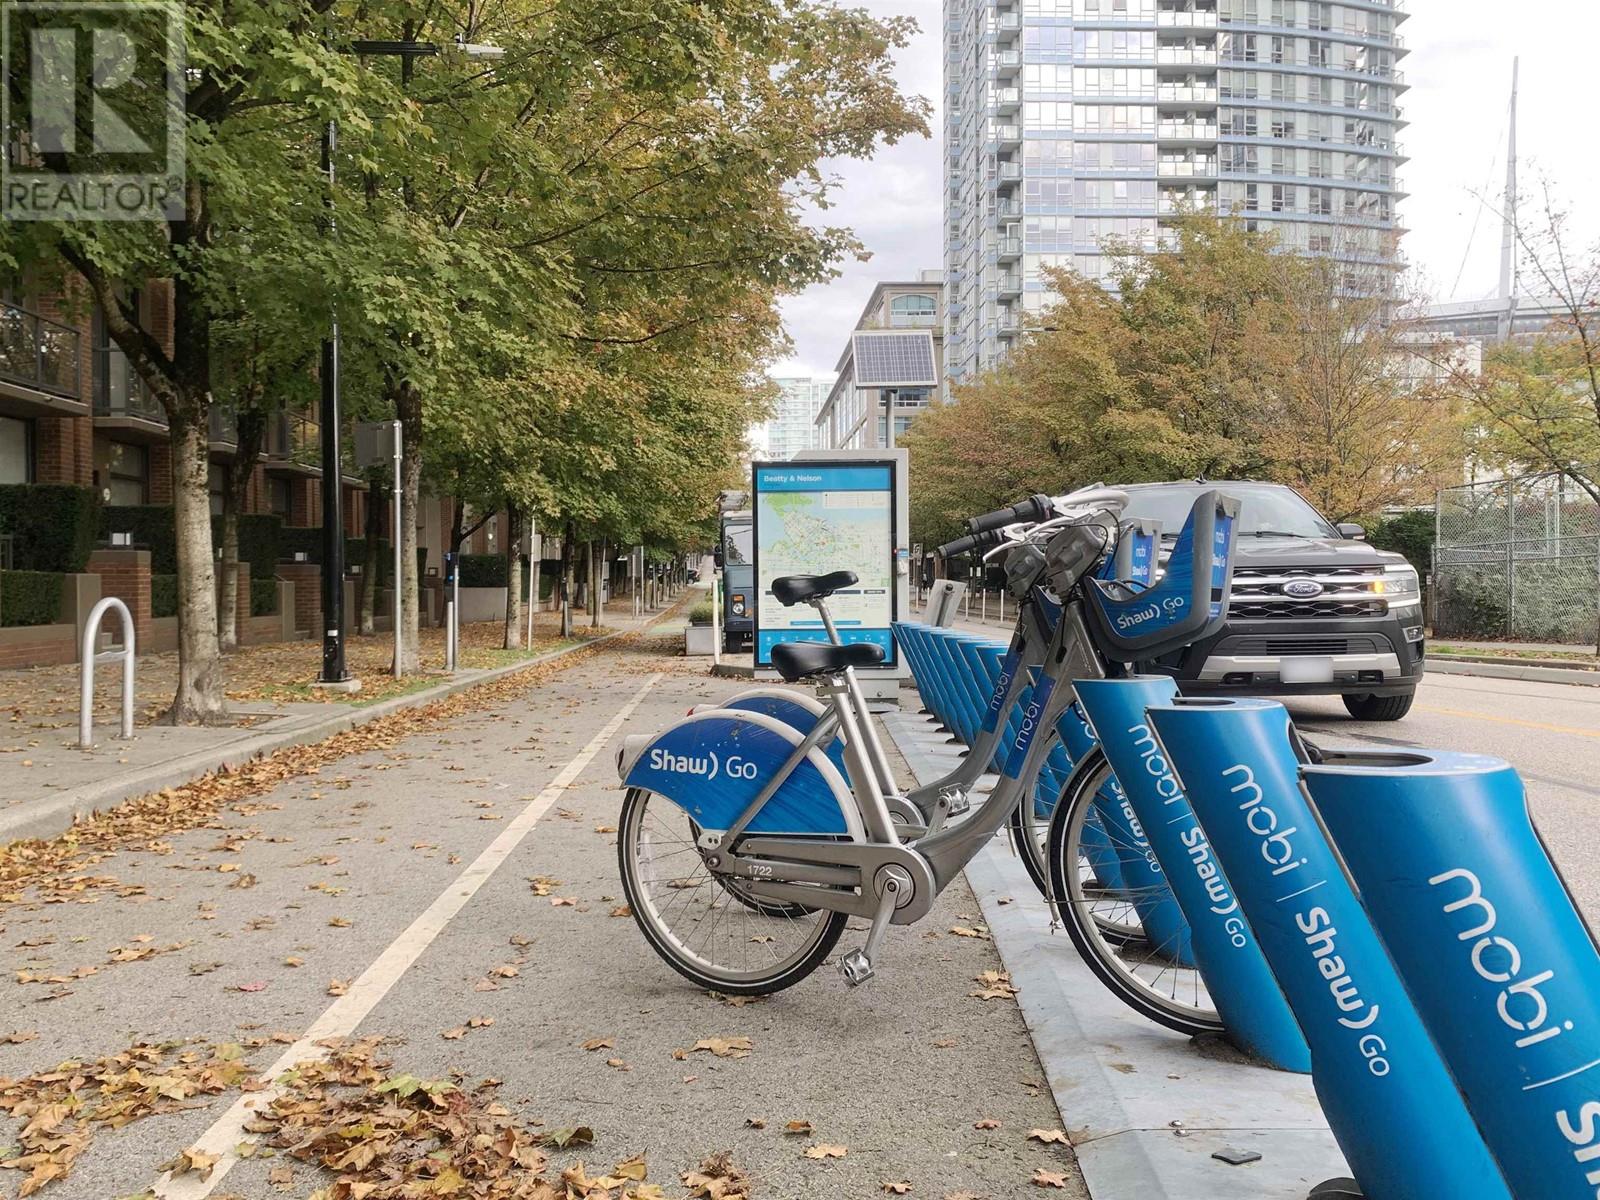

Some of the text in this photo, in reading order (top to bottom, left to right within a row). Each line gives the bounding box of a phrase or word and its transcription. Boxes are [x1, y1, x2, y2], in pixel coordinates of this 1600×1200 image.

[763, 475, 788, 483] Beatty
[1294, 584, 1314, 593] Ford
[1162, 597, 1184, 610] Go
[1014, 701, 1040, 750] mobi
[726, 756, 757, 779] Go
[747, 864, 773, 877] 1722
[1221, 763, 1308, 876] mobi
[1359, 1034, 1390, 1077] Go
[1225, 917, 1246, 948] Go
[1428, 868, 1574, 1048] mobi
